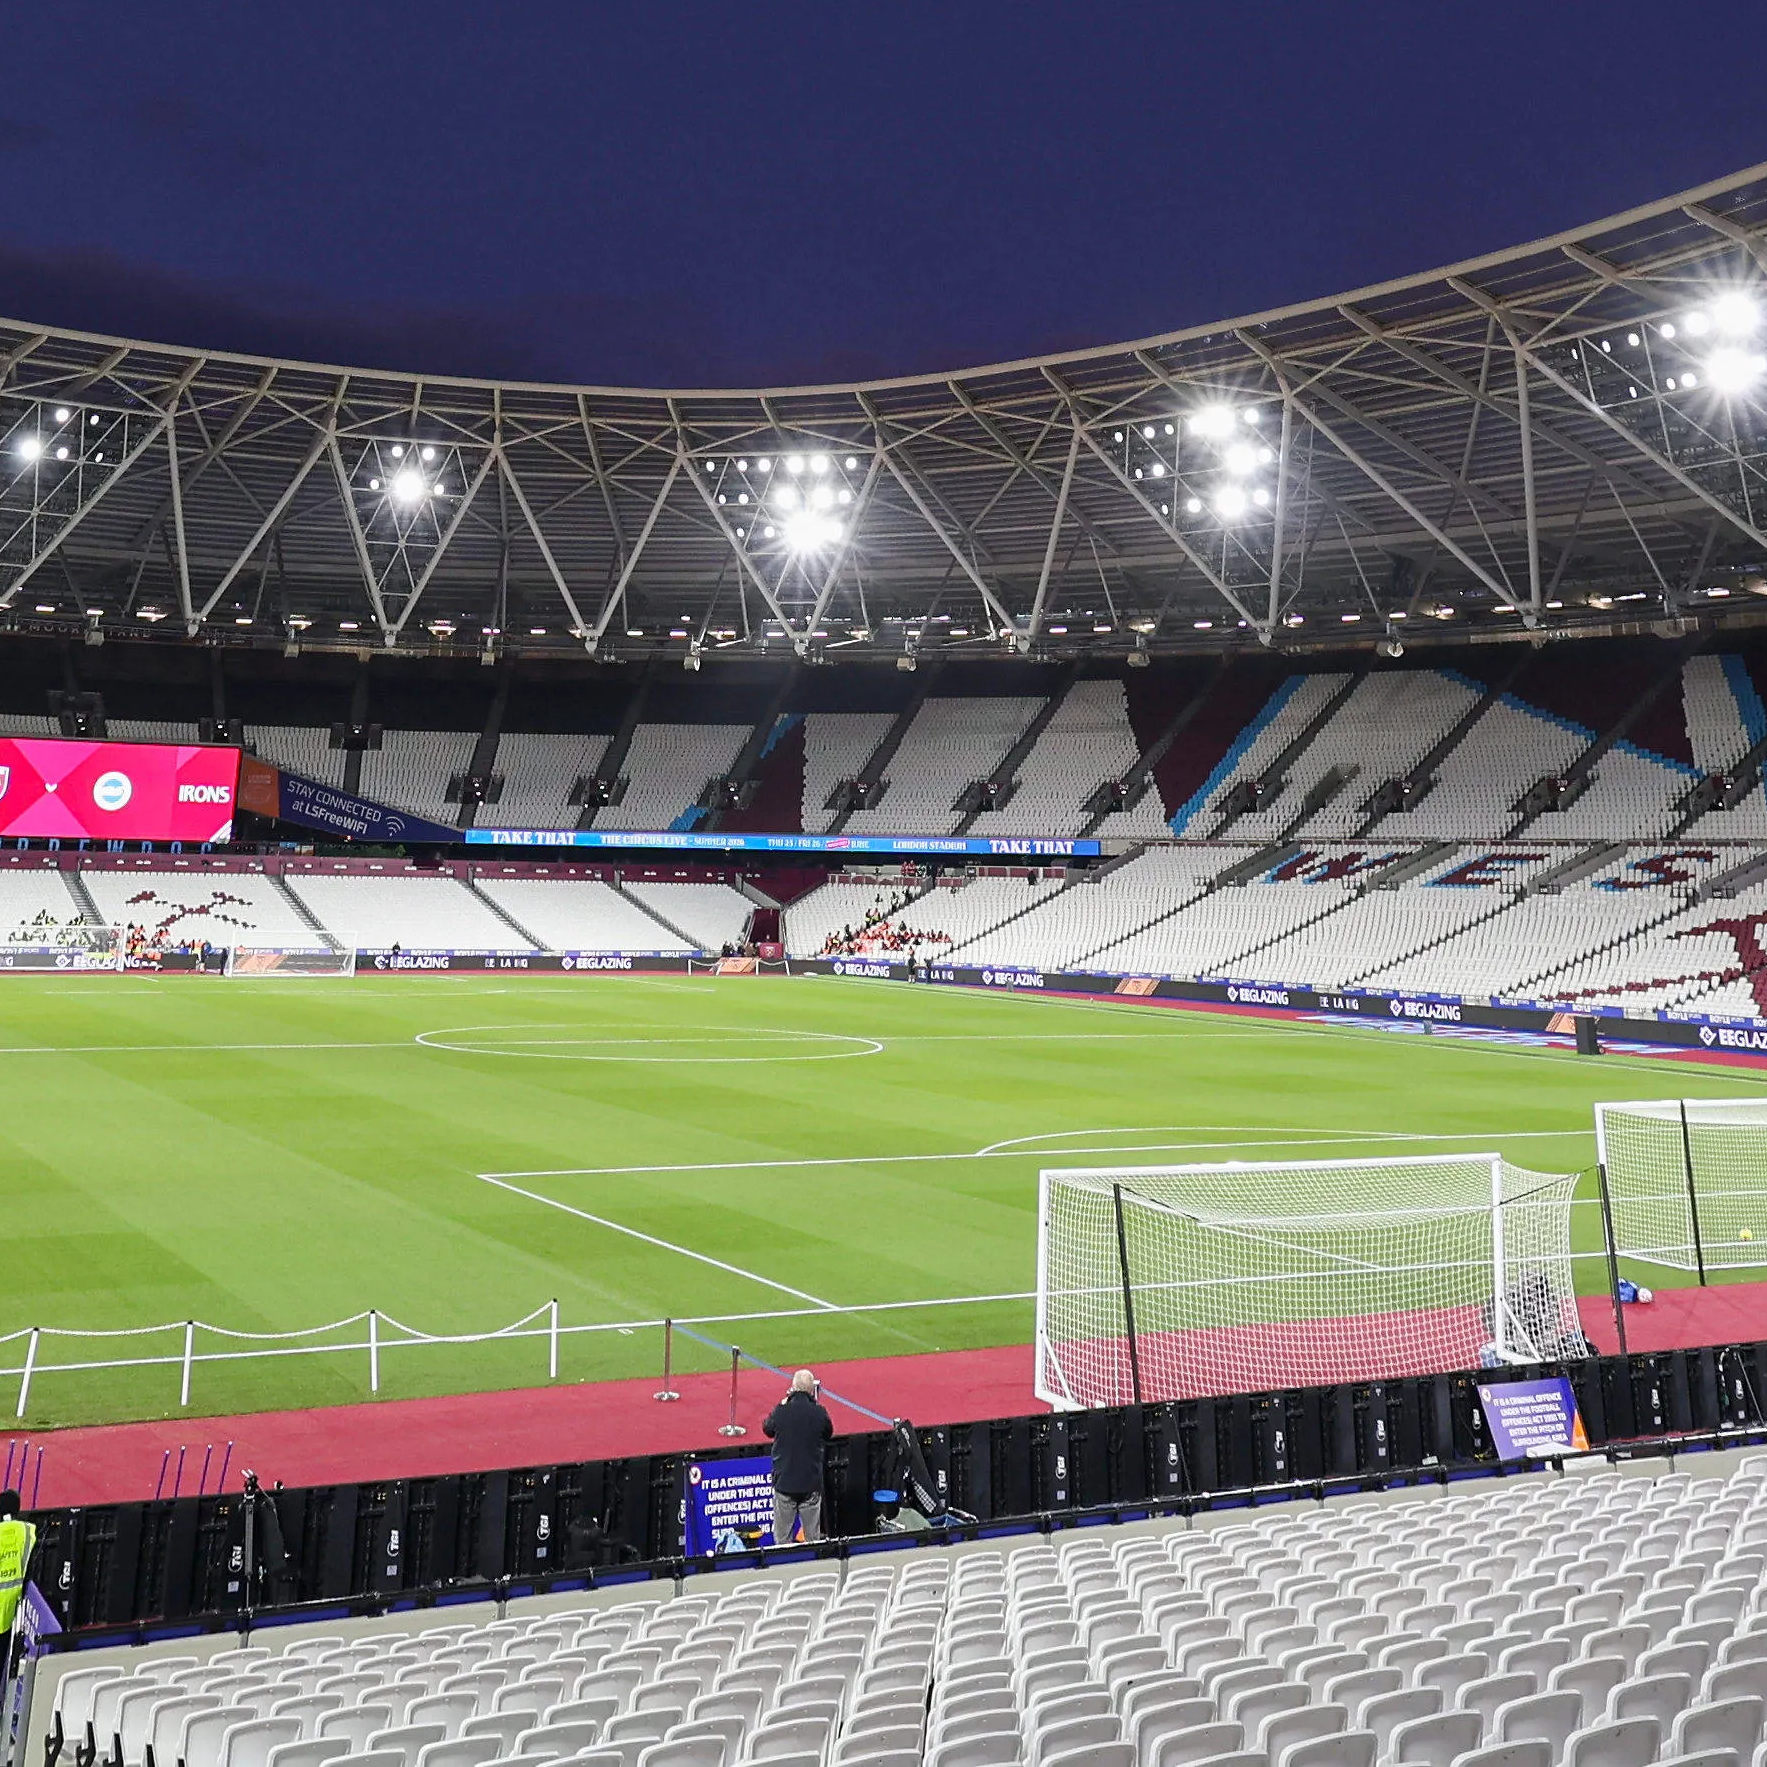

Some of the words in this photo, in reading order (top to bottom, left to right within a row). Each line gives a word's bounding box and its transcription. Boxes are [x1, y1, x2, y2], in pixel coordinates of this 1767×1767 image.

[178, 784, 231, 803] IRONS
[287, 780, 315, 798] STAY
[316, 790, 381, 822] CONNECTED
[292, 800, 303, 812] at
[491, 830, 532, 845] TAKE
[533, 831, 577, 846] THAT
[989, 839, 1031, 854] TAKE
[1031, 840, 1075, 854] THAT
[576, 957, 631, 969] EEGLAZING
[845, 962, 890, 978] EEGLAZING
[1239, 984, 1289, 1005] EEGLAZING
[1404, 999, 1461, 1022] EEGLAZING
[727, 1475, 766, 1487] CRIMINAL
[708, 1490, 737, 1502] UNDER
[737, 1488, 754, 1498] THE
[705, 1501, 751, 1516] (OFFENCES)
[752, 1500, 769, 1510] ACT
[711, 1514, 739, 1526] ENTER
[740, 1513, 756, 1523] THE
[757, 1511, 774, 1521] PITC
